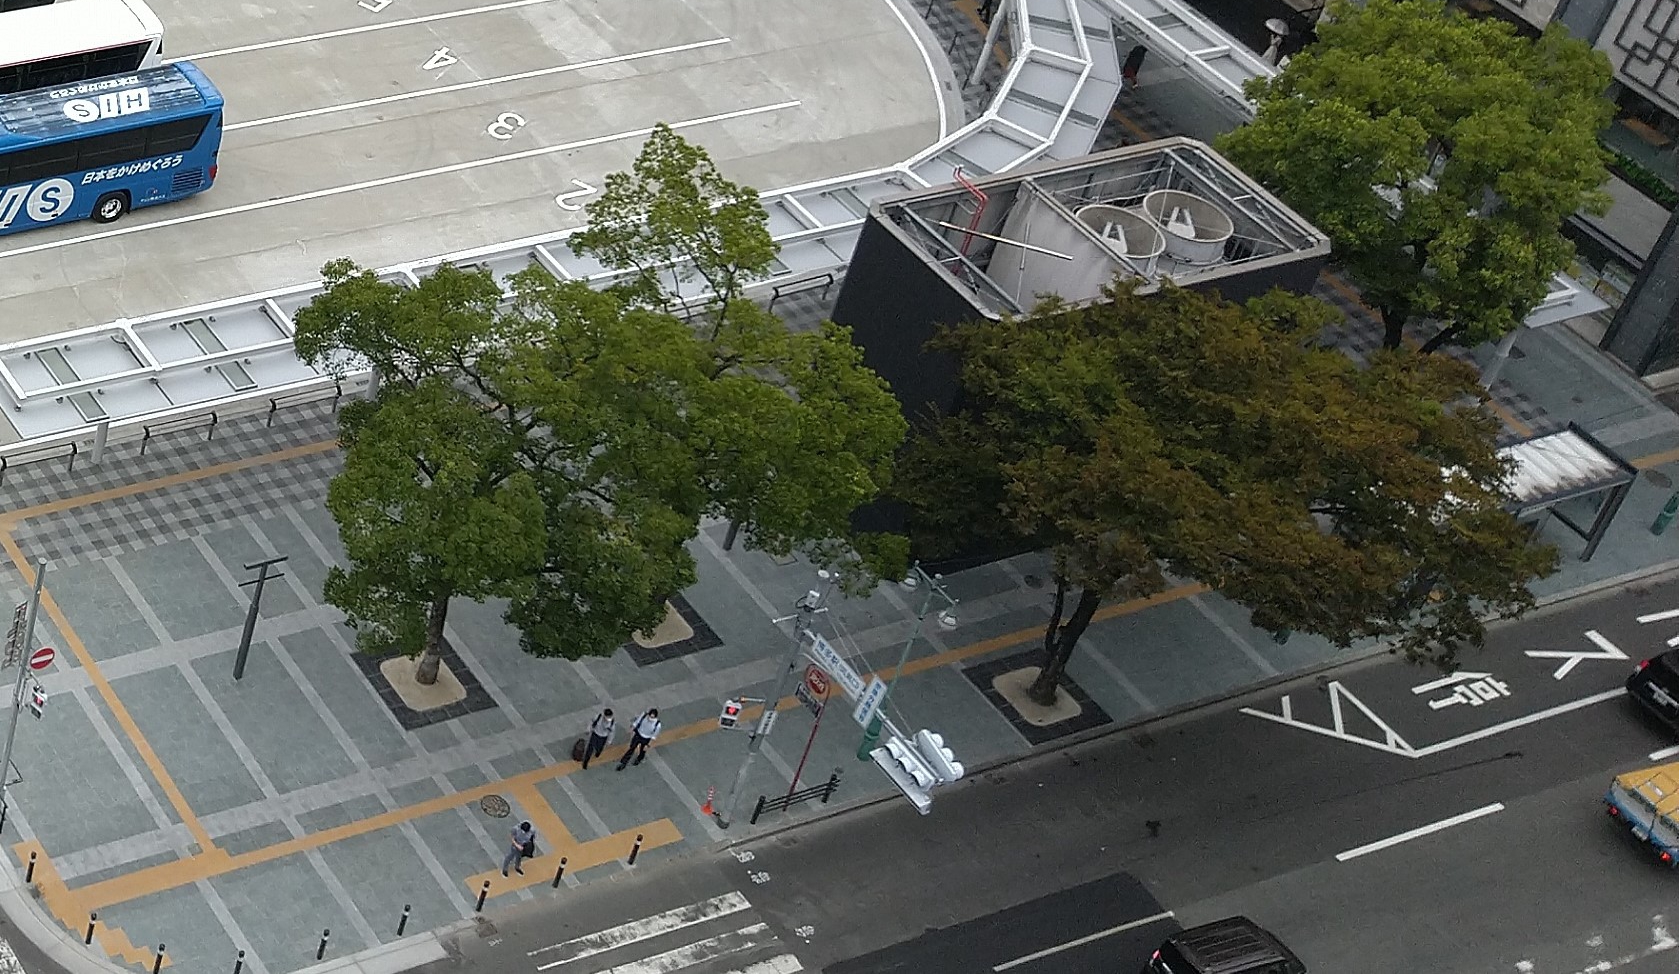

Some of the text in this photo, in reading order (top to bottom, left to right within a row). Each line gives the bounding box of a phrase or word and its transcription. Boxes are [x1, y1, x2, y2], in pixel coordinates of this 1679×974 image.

[422, 45, 458, 71] 4
[62, 86, 150, 123] HIS
[487, 111, 526, 140] 3
[81, 154, 183, 186] 日本をかけめぐろう
[555, 178, 598, 211] 2
